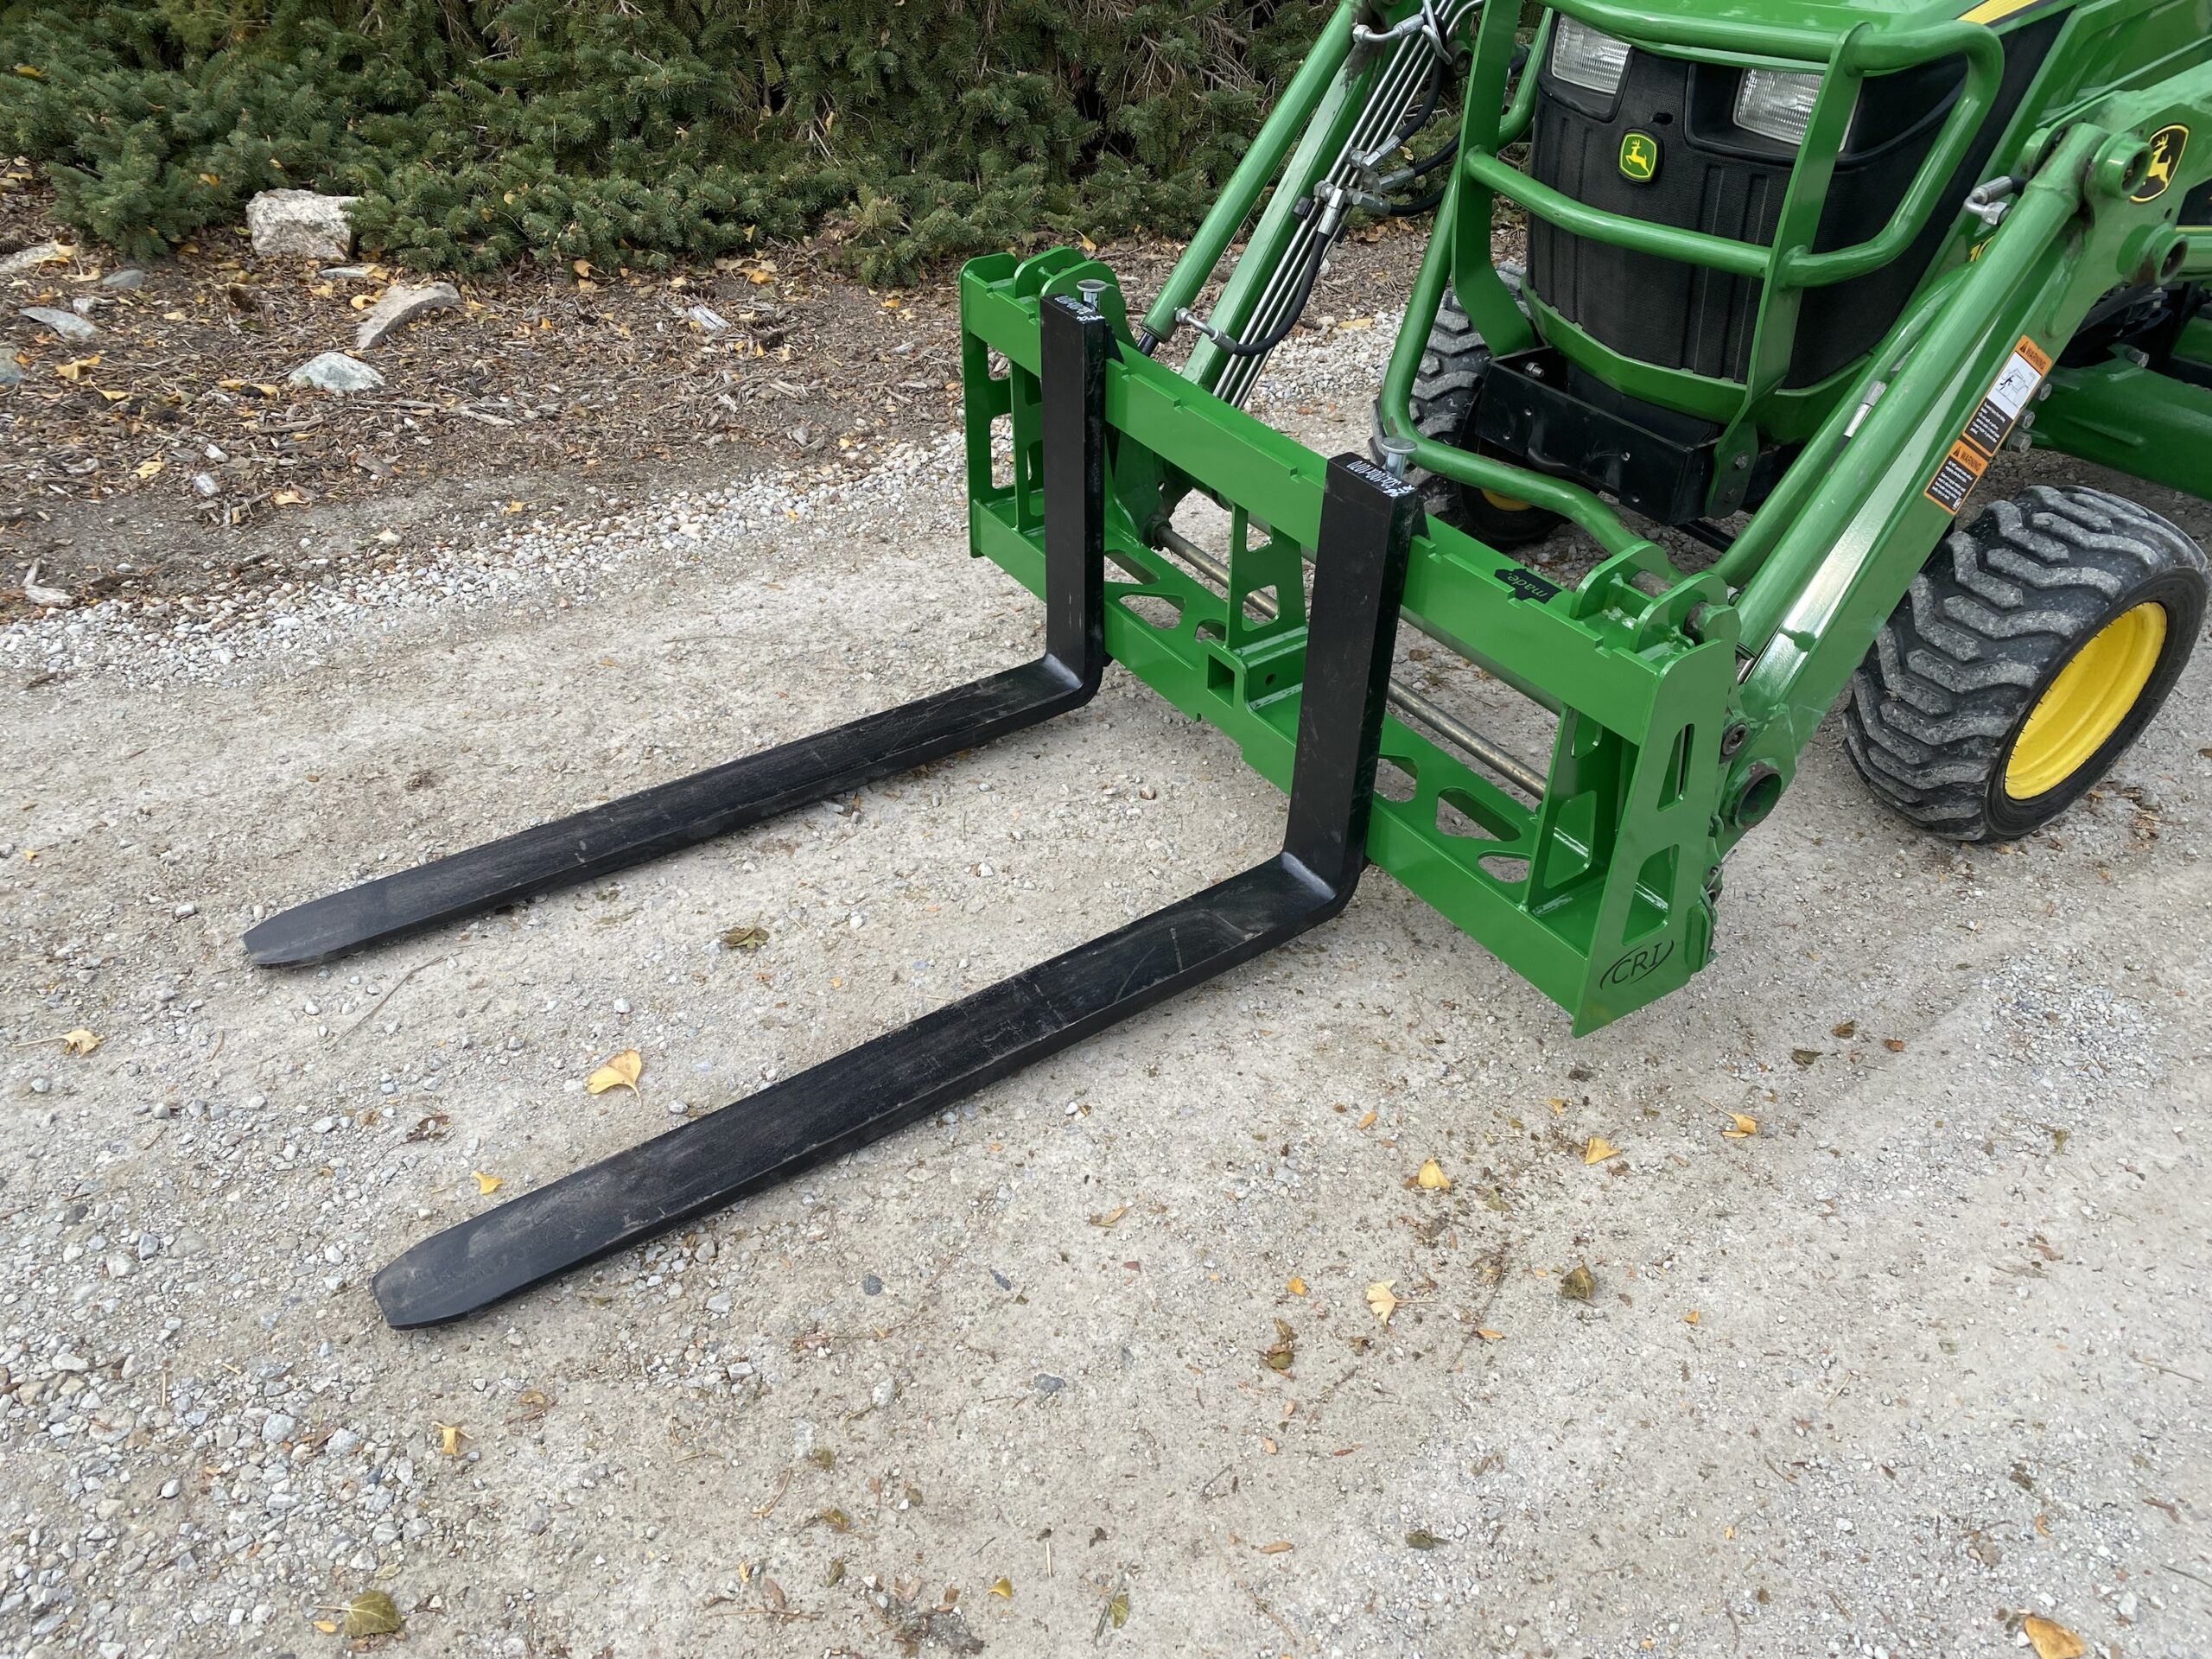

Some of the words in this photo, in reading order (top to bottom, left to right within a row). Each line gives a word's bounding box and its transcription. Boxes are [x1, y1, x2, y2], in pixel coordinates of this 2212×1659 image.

[2025, 346, 2047, 371] WARNING
[1961, 451, 1982, 473] WARNING
[1611, 942, 1663, 984] CRI
